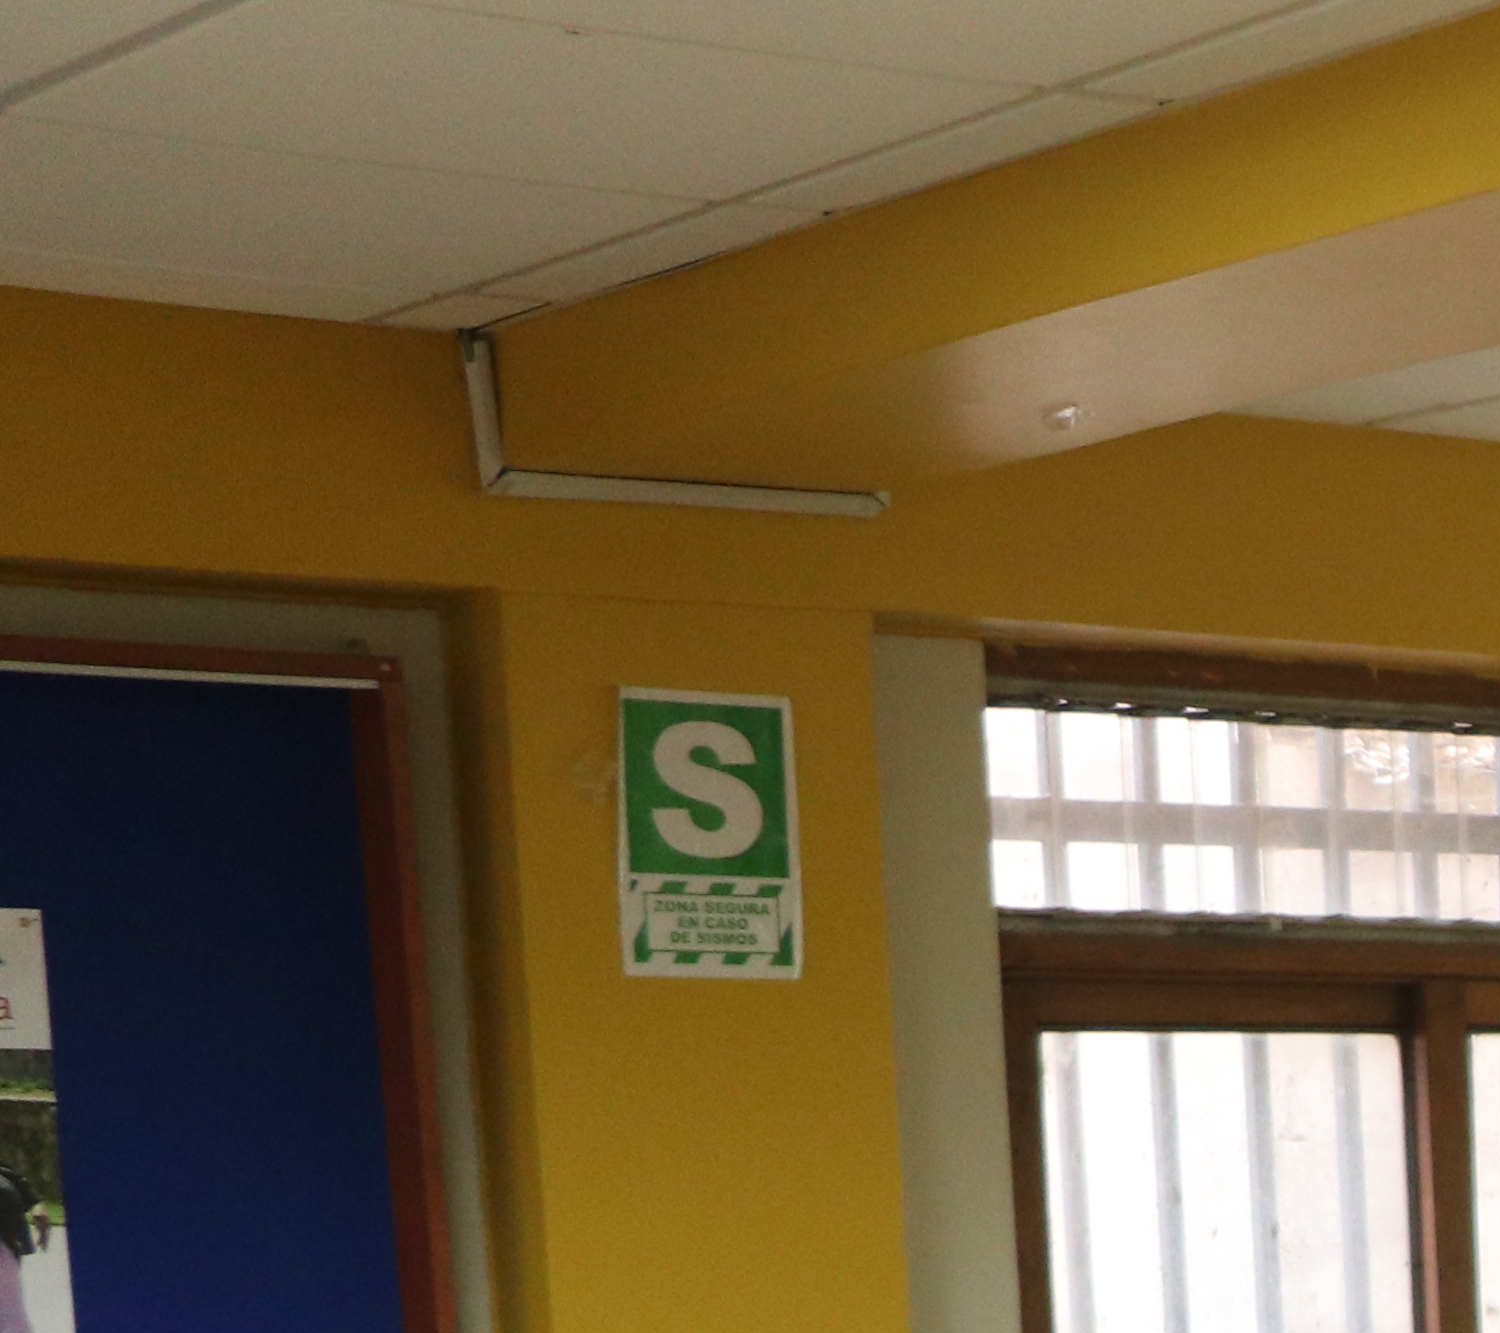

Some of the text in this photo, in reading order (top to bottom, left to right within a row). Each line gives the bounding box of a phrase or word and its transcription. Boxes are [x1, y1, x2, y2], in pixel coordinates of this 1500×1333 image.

[652, 720, 764, 860] S
[654, 901, 770, 915] ZONA SEGURA
[678, 915, 748, 930] EN CASO
[670, 931, 758, 945] DE SISMOS
